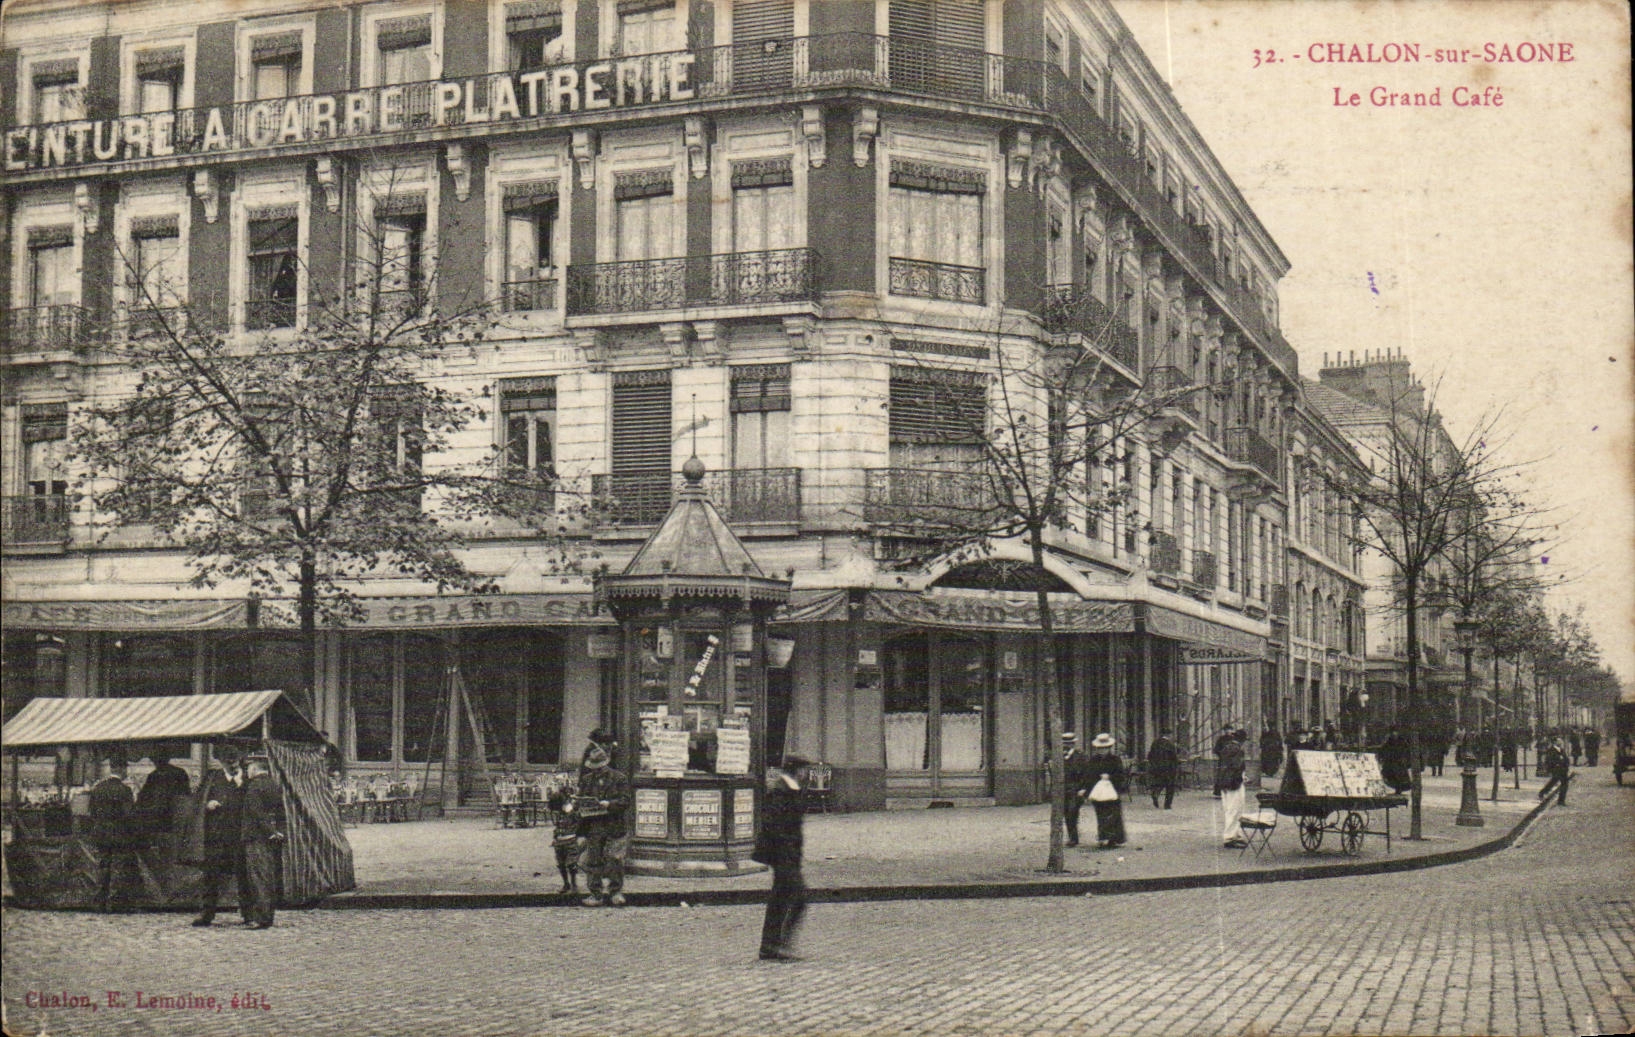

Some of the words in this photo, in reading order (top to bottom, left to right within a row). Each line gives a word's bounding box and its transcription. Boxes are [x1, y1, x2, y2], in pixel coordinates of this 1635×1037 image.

[202, 107, 228, 151] A
[436, 53, 694, 125] PLATRERIE
[387, 600, 522, 623] GRAND
